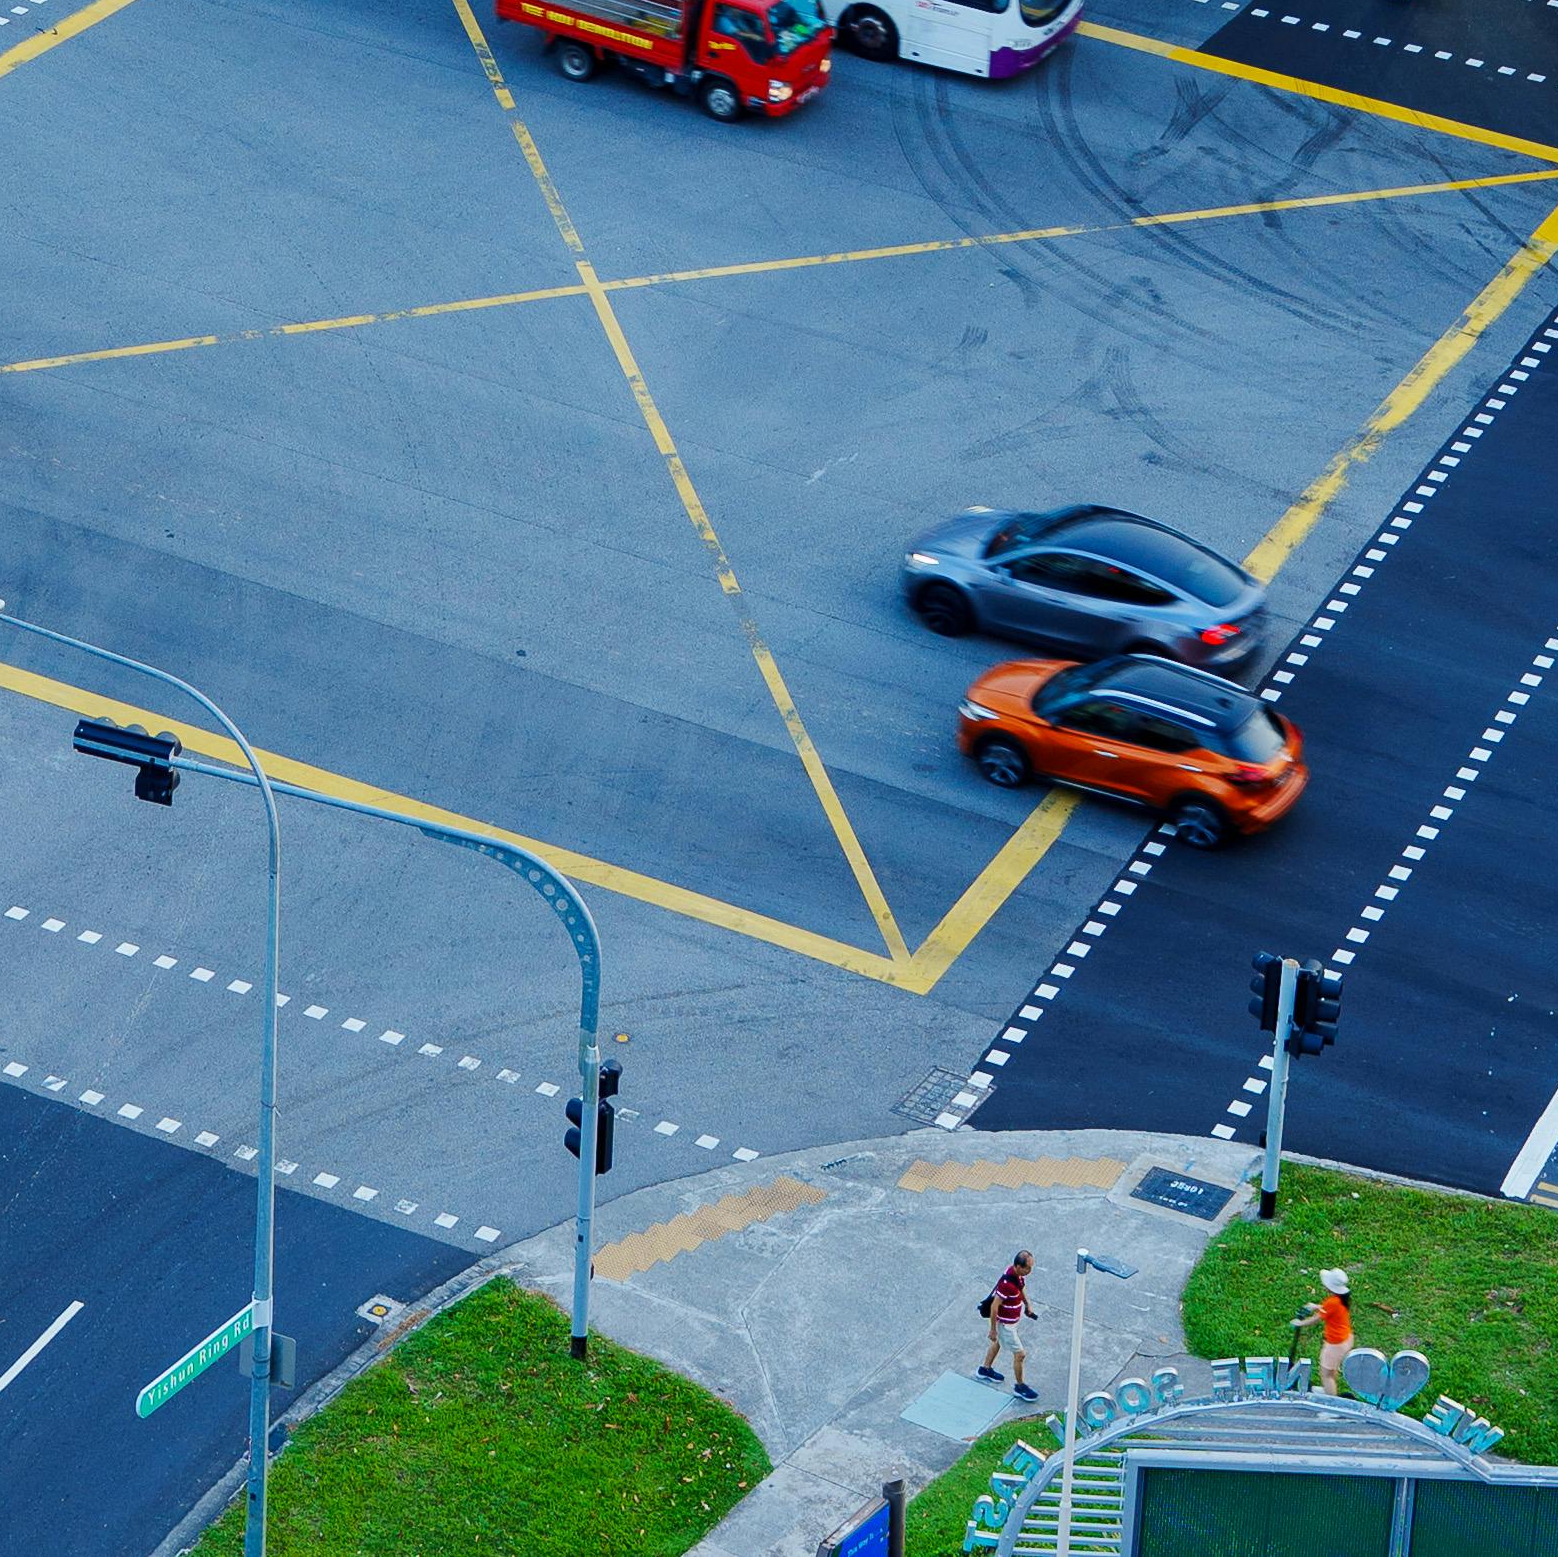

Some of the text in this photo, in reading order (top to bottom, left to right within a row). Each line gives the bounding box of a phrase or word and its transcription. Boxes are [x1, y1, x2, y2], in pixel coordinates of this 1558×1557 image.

[147, 1313, 249, 1405] Yishun Ring Rd
